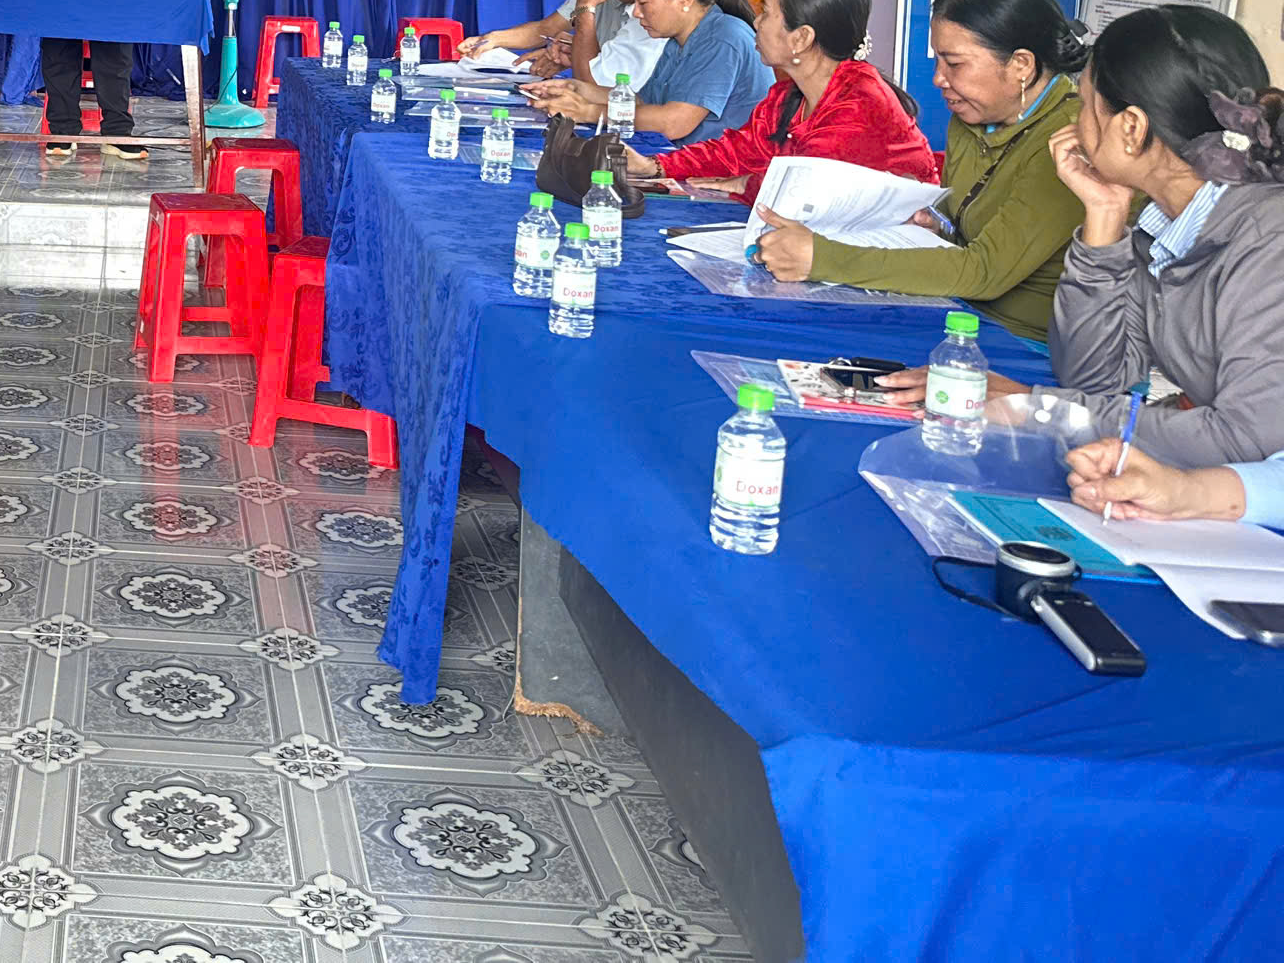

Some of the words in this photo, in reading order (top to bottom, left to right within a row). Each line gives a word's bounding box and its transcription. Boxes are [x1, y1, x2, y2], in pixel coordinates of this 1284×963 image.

[593, 224, 619, 233] Doxan
[563, 287, 593, 298] Doxan
[736, 480, 779, 495] Doxan
